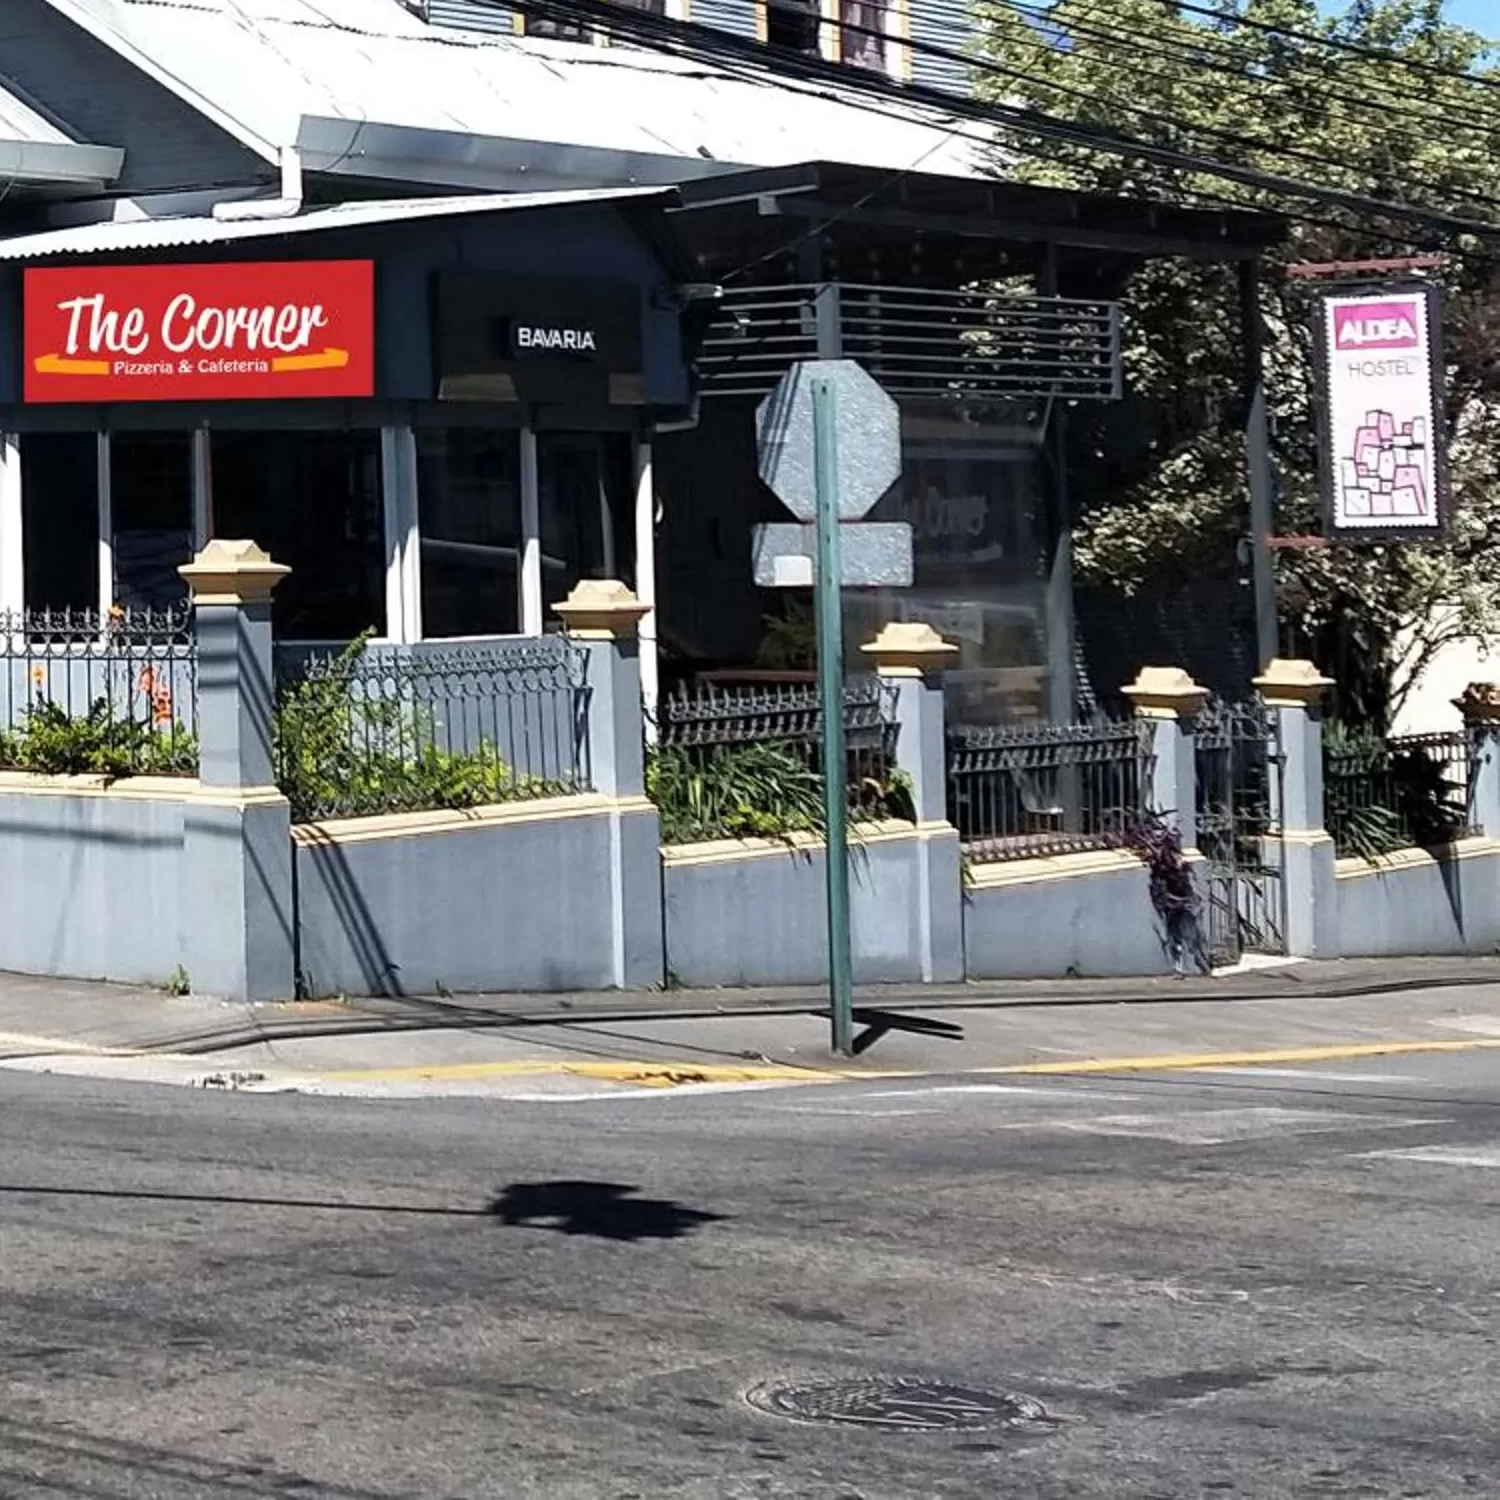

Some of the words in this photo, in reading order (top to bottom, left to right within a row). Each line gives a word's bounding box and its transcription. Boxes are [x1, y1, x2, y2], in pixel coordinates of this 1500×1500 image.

[56, 292, 149, 355] The
[161, 292, 329, 353] Corner
[1338, 317, 1417, 345] ALDEA
[518, 327, 597, 351] BAVARIA
[113, 359, 174, 376] Pizzeria
[178, 359, 193, 374] &
[197, 357, 269, 374] Cafeteria
[1347, 359, 1415, 379] HOSTEL
